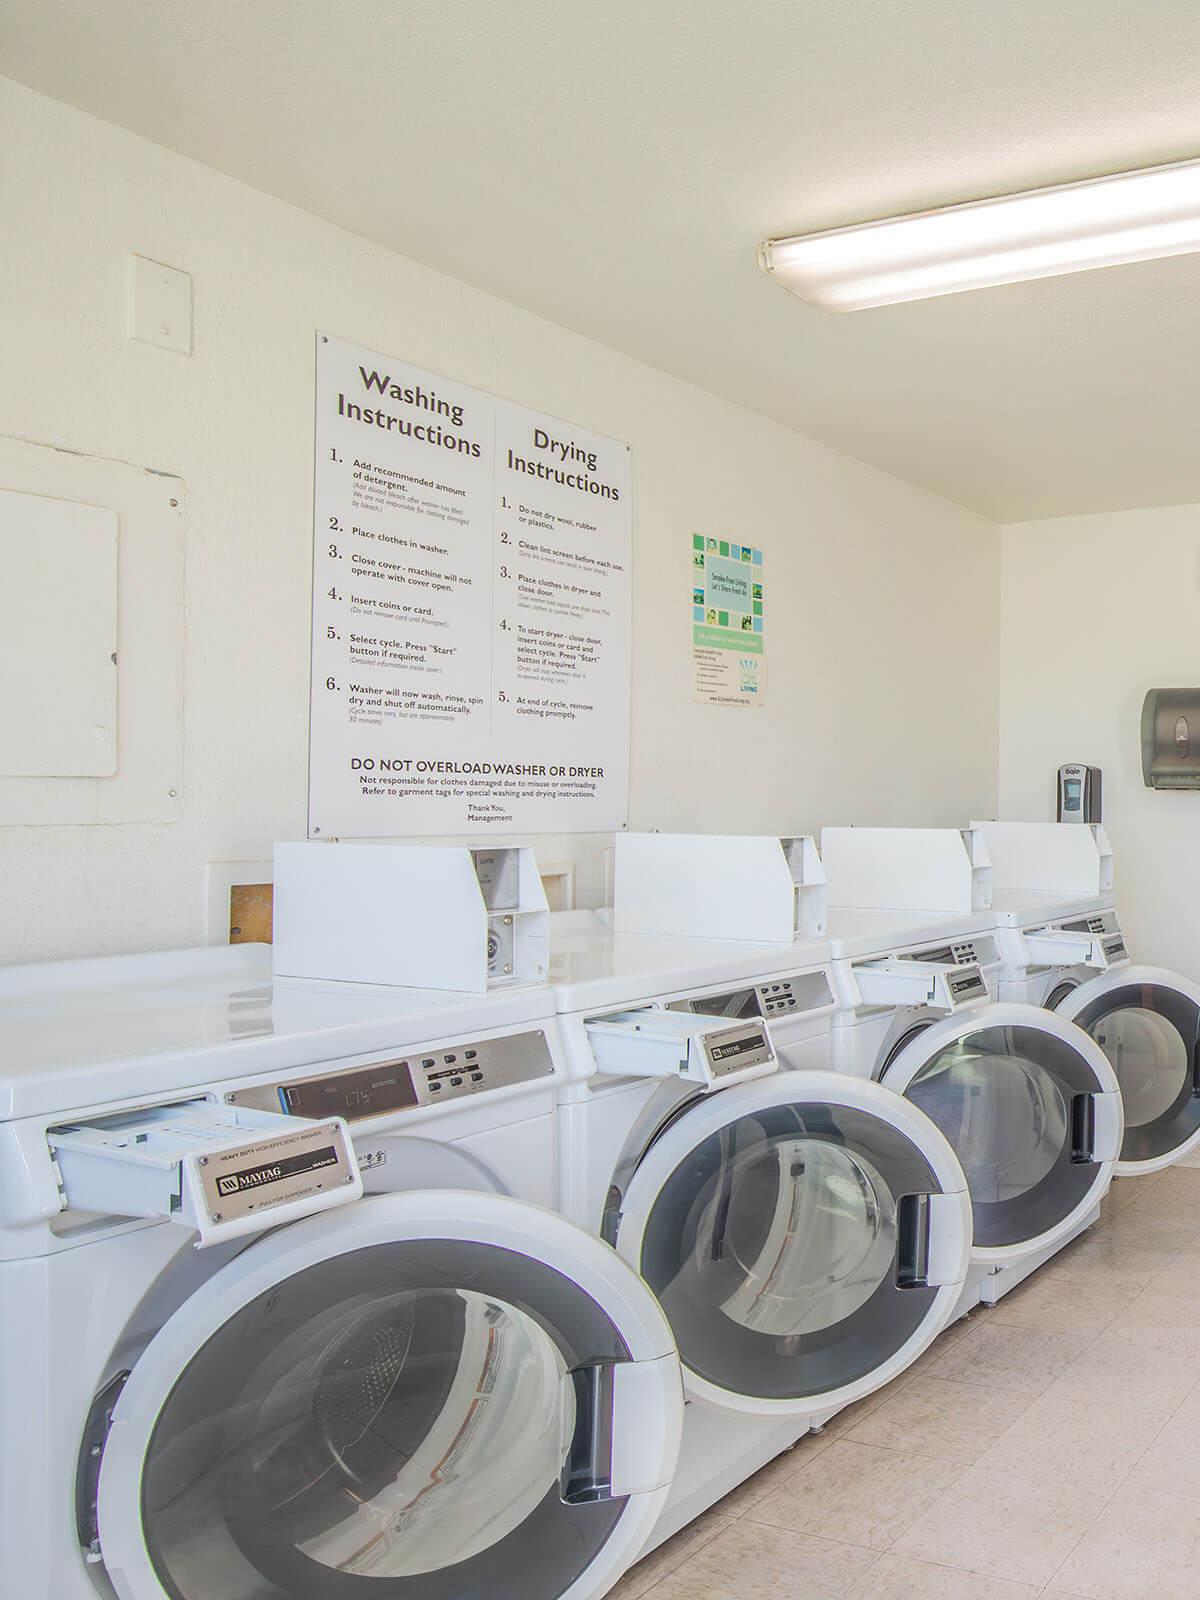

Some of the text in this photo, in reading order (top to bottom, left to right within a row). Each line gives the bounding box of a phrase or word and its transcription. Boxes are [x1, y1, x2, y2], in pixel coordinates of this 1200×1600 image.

[359, 366, 464, 426] Washing
[338, 394, 482, 458] Instructions
[533, 428, 598, 472] Drying
[330, 448, 466, 496] 1. Add recommended amount
[353, 472, 408, 492] of detergent.
[507, 449, 620, 501] Instructions
[501, 497, 597, 532] 1. Do not dry wool, rubber
[528, 519, 555, 530] plastics.
[329, 516, 449, 555] 2. Place clothes in washer.
[501, 532, 512, 545] 2.
[518, 541, 539, 551] Clean
[540, 546, 551, 554] lint
[553, 551, 574, 559] screen
[575, 555, 595, 565] before
[597, 560, 611, 569] each
[329, 544, 472, 585] 3. Close cover machine will not
[351, 568, 454, 592] operate with cover open.
[500, 566, 512, 579] 3.
[518, 574, 536, 584] Place
[538, 579, 562, 590] clothes
[571, 586, 588, 594] dryer
[518, 585, 555, 597] close door.
[328, 587, 342, 600] 4.
[351, 595, 377, 607] Insert
[379, 602, 401, 611] coins
[414, 608, 434, 616] card.
[327, 626, 457, 656] 5. Select cycle. Press "Start"
[500, 619, 603, 646] 4. To start dryer close door,
[518, 636, 538, 645] insert
[539, 640, 556, 648] coins
[567, 644, 580, 652] card
[350, 646, 379, 657] button
[389, 652, 427, 663] required.
[517, 646, 601, 664] select cycle. Press "Start"
[517, 656, 541, 665] button
[548, 661, 577, 670] required.
[326, 677, 341, 691] 6.
[349, 684, 383, 695] Washer
[422, 693, 443, 702] wash,
[445, 695, 467, 704] rinse,
[349, 696, 364, 706] dry
[384, 700, 402, 708] shut
[405, 701, 416, 709] off
[417, 703, 472, 715] automatically.
[499, 691, 510, 702] 5.
[517, 696, 526, 704] At
[550, 702, 569, 710] cycle,
[570, 703, 594, 711] remove
[517, 707, 577, 720] clothing promptly.
[351, 758, 605, 778] DO NOT OVERLOAD WASHER OR DRYER
[360, 776, 377, 785] Not
[379, 777, 425, 787] responsible
[427, 778, 439, 786] for
[440, 778, 468, 786] clothes
[469, 779, 502, 788] damaged
[560, 781, 597, 790] overloading.
[362, 787, 386, 795] Refer
[399, 788, 434, 798] garment
[435, 789, 452, 798] tags
[453, 789, 465, 797] for
[466, 790, 491, 798] special
[492, 790, 521, 798] washing
[522, 790, 535, 798] and
[535, 791, 556, 799] drying
[557, 791, 596, 799] instructions.
[467, 814, 513, 823] Management
[490, 805, 506, 813] You,
[312, 1158, 336, 1168] WASHER
[240, 1167, 281, 1186] MAYTAG
